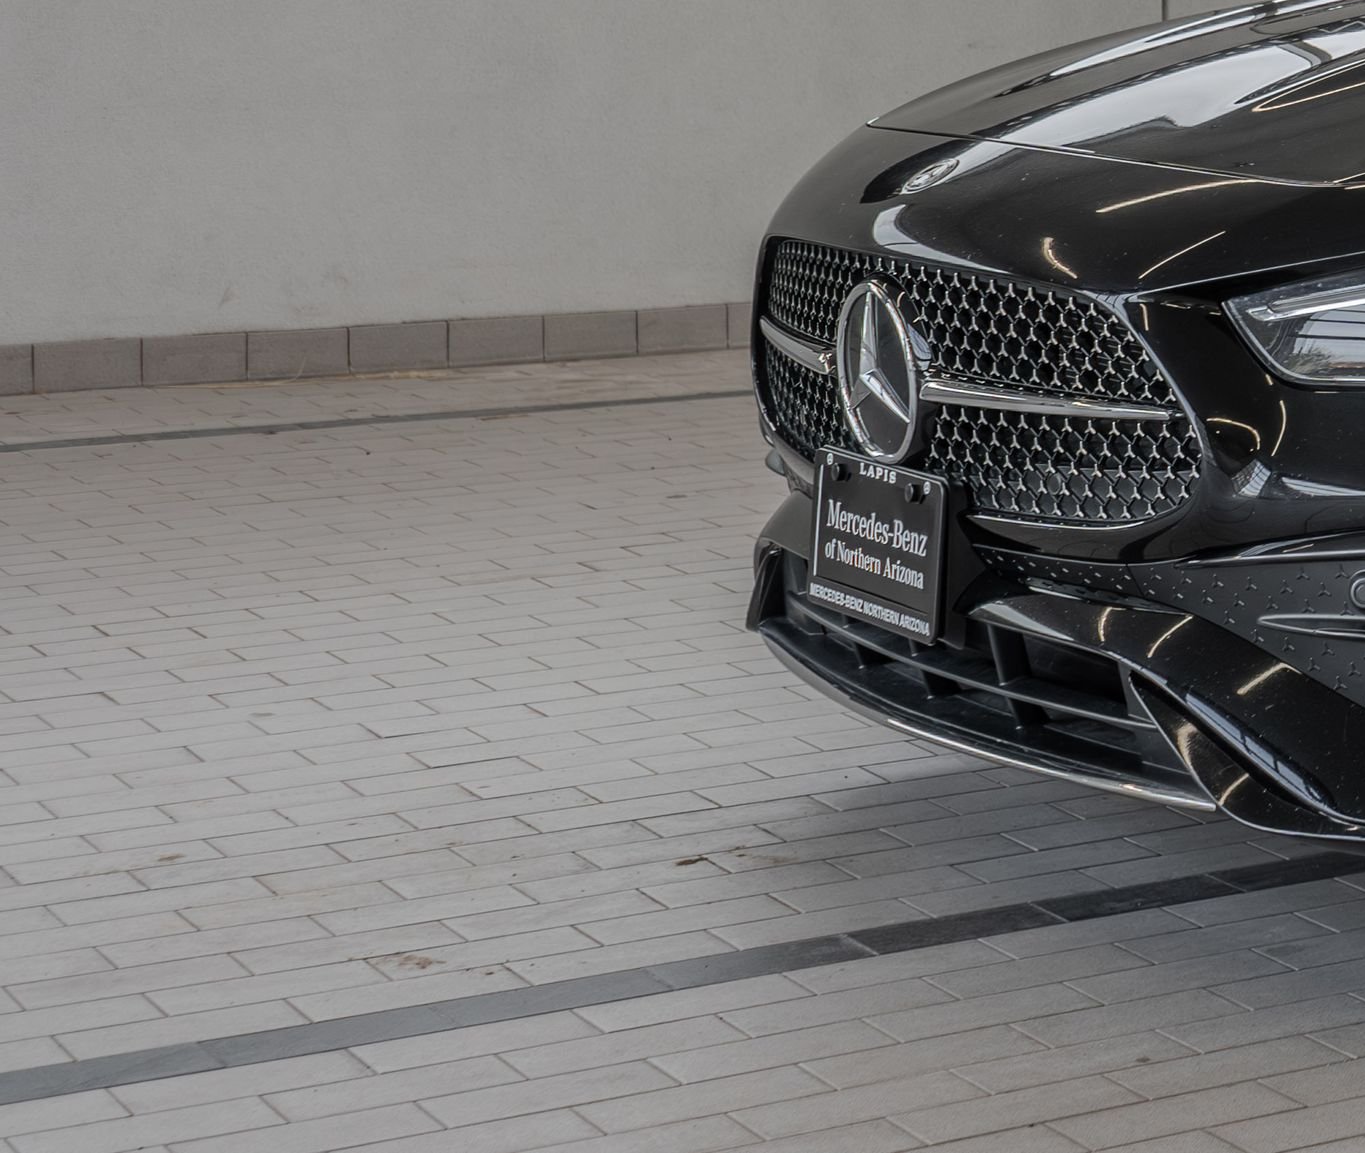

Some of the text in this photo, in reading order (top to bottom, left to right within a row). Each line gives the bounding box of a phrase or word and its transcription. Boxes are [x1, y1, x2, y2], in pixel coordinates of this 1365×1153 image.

[859, 462, 897, 484] LAPIS
[826, 499, 929, 557] Mercedes-Benz
[824, 538, 924, 589] of Northern Arizona
[809, 582, 930, 636] MERCEDES-BENZ NORTHERN ARIZONA
